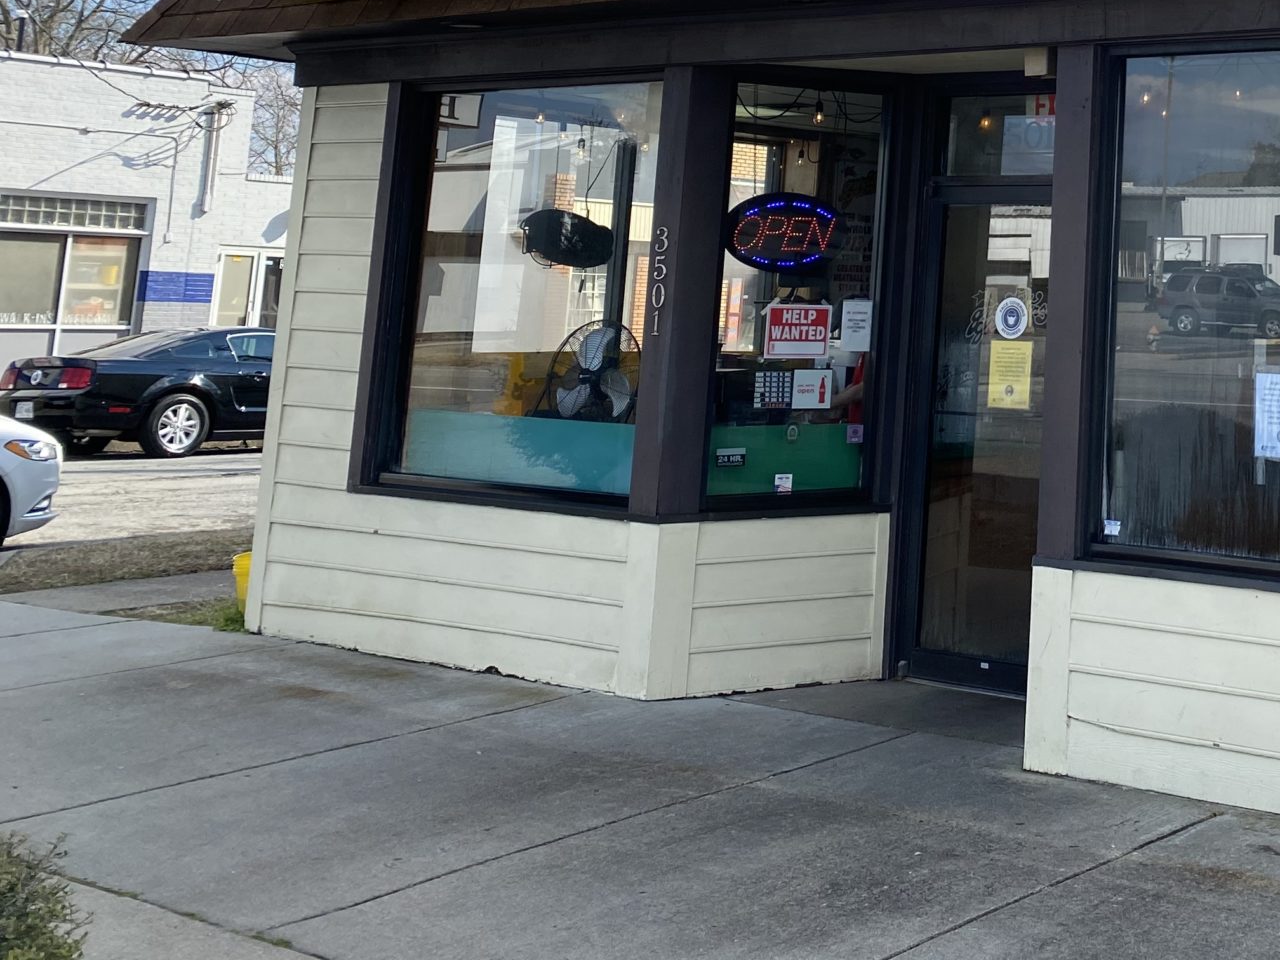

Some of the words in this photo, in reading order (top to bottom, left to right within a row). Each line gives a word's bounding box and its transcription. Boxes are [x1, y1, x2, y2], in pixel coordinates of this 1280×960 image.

[733, 215, 836, 251] OPEN
[651, 226, 669, 336] 3501
[782, 309, 817, 324] HELP
[771, 325, 825, 340] WANTED
